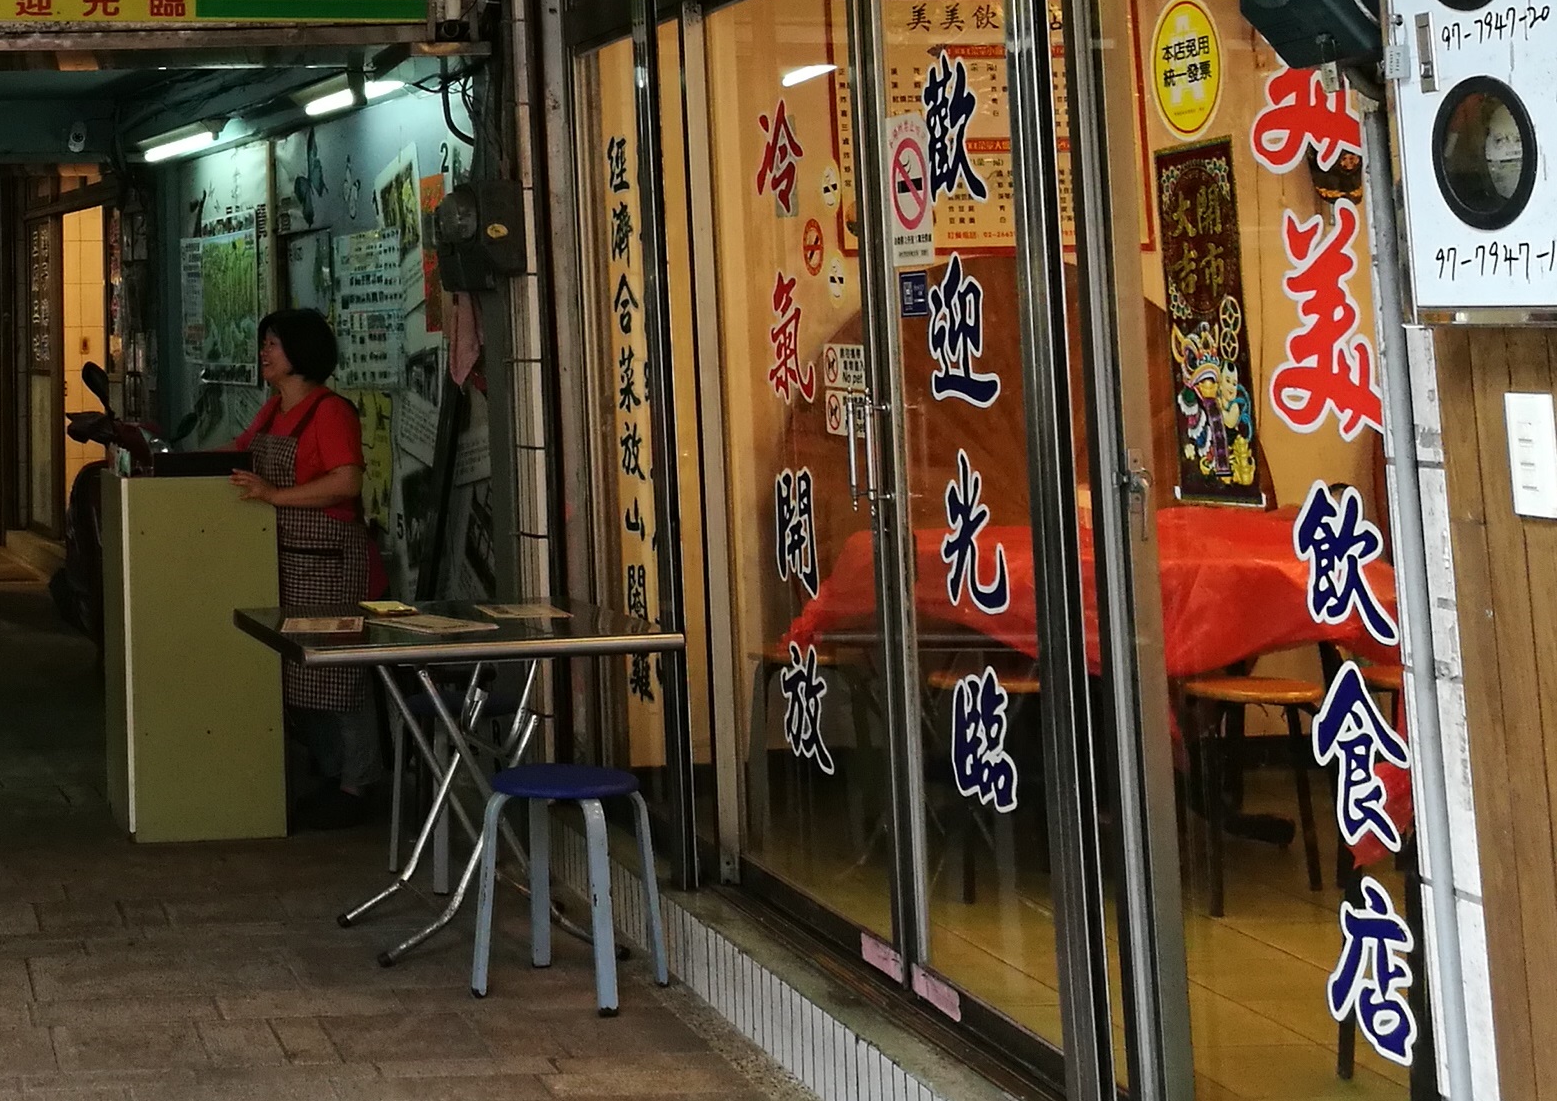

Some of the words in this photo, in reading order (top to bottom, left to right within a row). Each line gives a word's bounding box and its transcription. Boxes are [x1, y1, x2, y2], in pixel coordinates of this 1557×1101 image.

[1441, 6, 1551, 52] 97-7947-20
[1162, 35, 1210, 62] 本店免用
[1163, 60, 1213, 87] 統一發票
[842, 371, 851, 384] No
[756, 98, 836, 776] 冷氣開放
[922, 49, 1019, 814] 歡迎光臨
